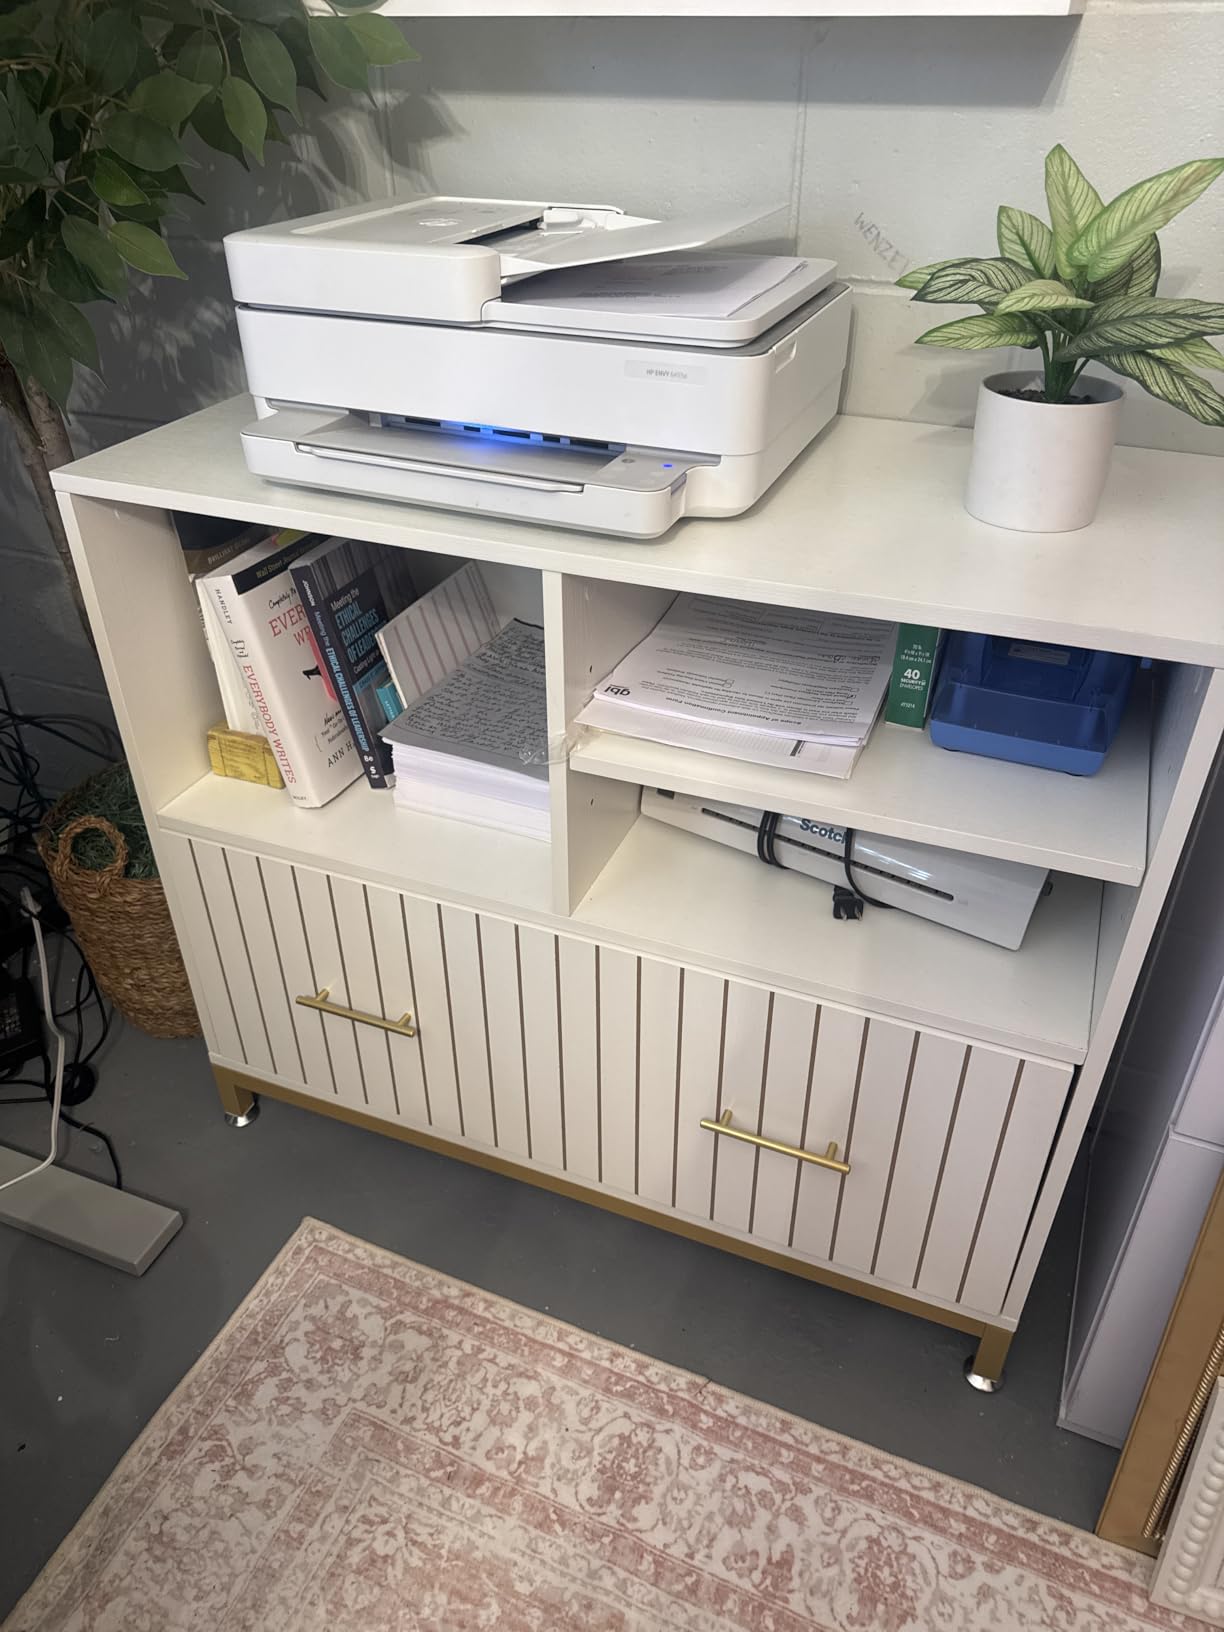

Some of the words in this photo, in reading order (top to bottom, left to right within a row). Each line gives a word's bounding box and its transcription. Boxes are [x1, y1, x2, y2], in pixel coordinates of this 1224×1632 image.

[646, 368, 655, 376] HP
[655, 369, 670, 377] ENVY
[302, 580, 316, 607] JOHNSON
[330, 593, 354, 612] Meeting
[349, 587, 360, 600] the
[215, 588, 233, 625] HANDLEY
[335, 600, 362, 630] ETHICAL
[341, 608, 380, 647] CHALLENGES
[347, 645, 358, 664] OF
[314, 611, 327, 637] Meeting
[325, 647, 341, 674] ETHICAL
[334, 671, 356, 711] CHALLENGES
[351, 716, 370, 752] LEADERSHIP
[903, 668, 920, 680] 40
[603, 684, 631, 697] gbl
[665, 696, 683, 705] Form
[683, 700, 727, 714] Confirmation
[727, 709, 771, 722] Appointment
[242, 664, 279, 738] EVERYBODY
[271, 737, 297, 785] WRITES
[327, 747, 345, 768] ANN
